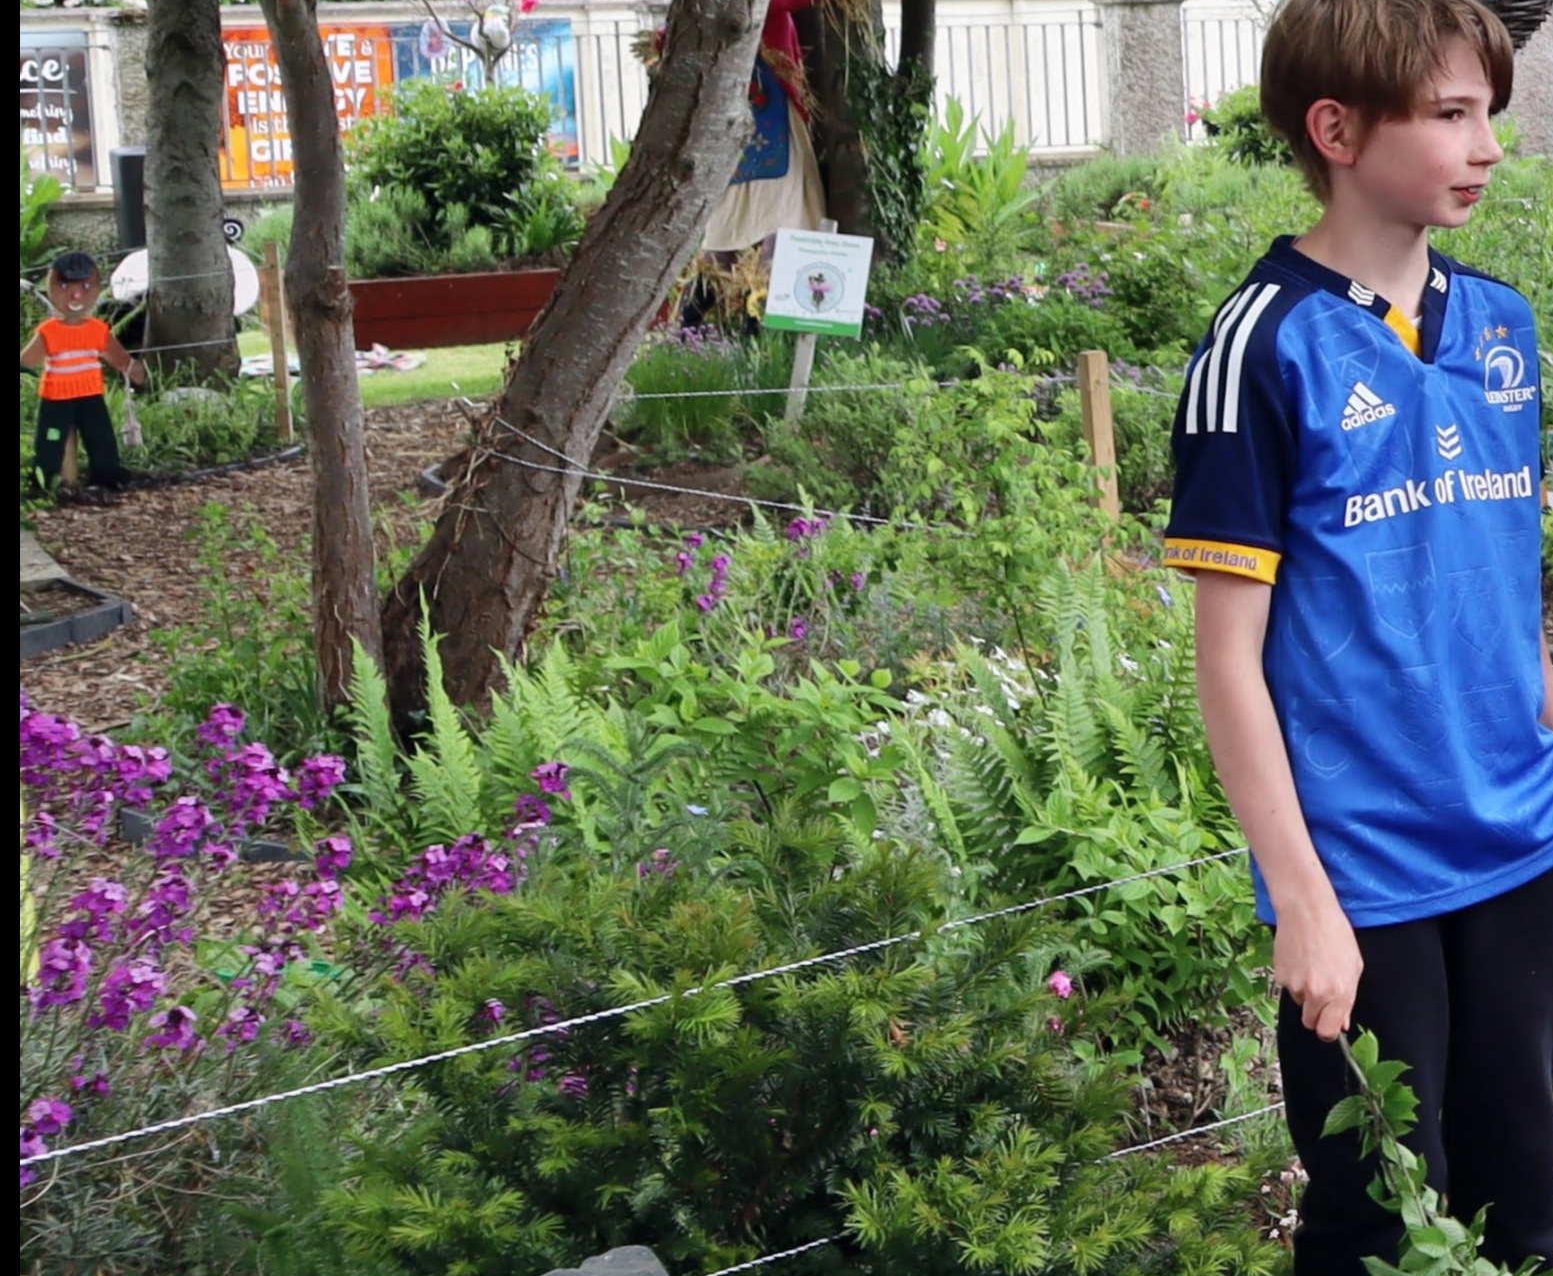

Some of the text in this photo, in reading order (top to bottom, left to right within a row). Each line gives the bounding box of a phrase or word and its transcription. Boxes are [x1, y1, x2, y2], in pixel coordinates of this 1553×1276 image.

[20, 58, 70, 83] ce
[228, 59, 373, 88] POSVE
[237, 87, 367, 115] ENGY
[1341, 402, 1397, 431] adidas
[1344, 465, 1533, 528] Bank of Ireland
[1164, 545, 1257, 571] nk of Ireland
